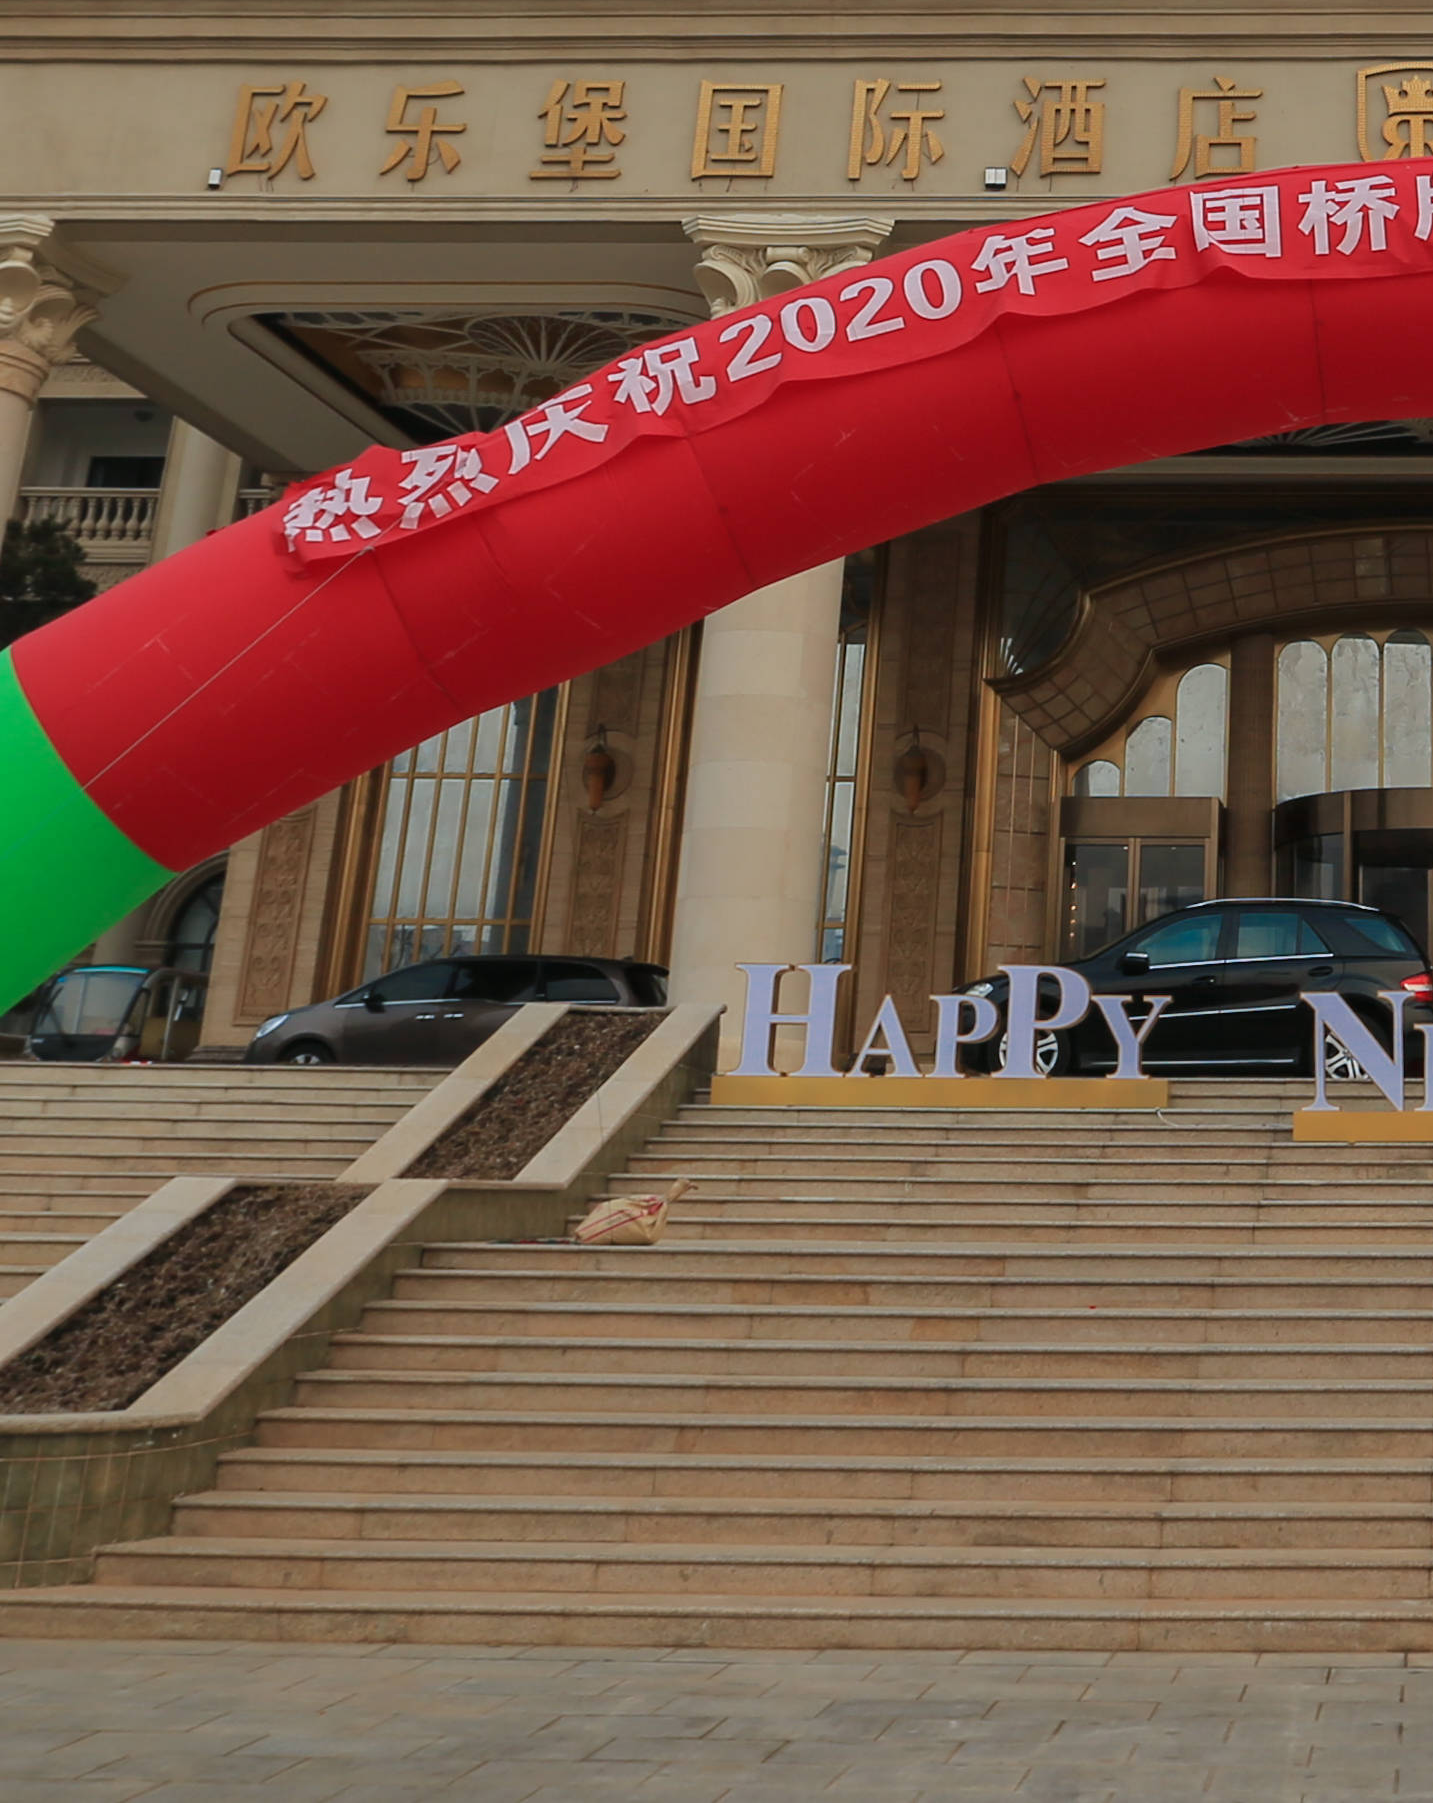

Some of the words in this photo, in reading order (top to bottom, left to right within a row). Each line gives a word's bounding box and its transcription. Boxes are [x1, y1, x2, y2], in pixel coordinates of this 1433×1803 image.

[225, 77, 1263, 181] 欧乐堡国际酒店
